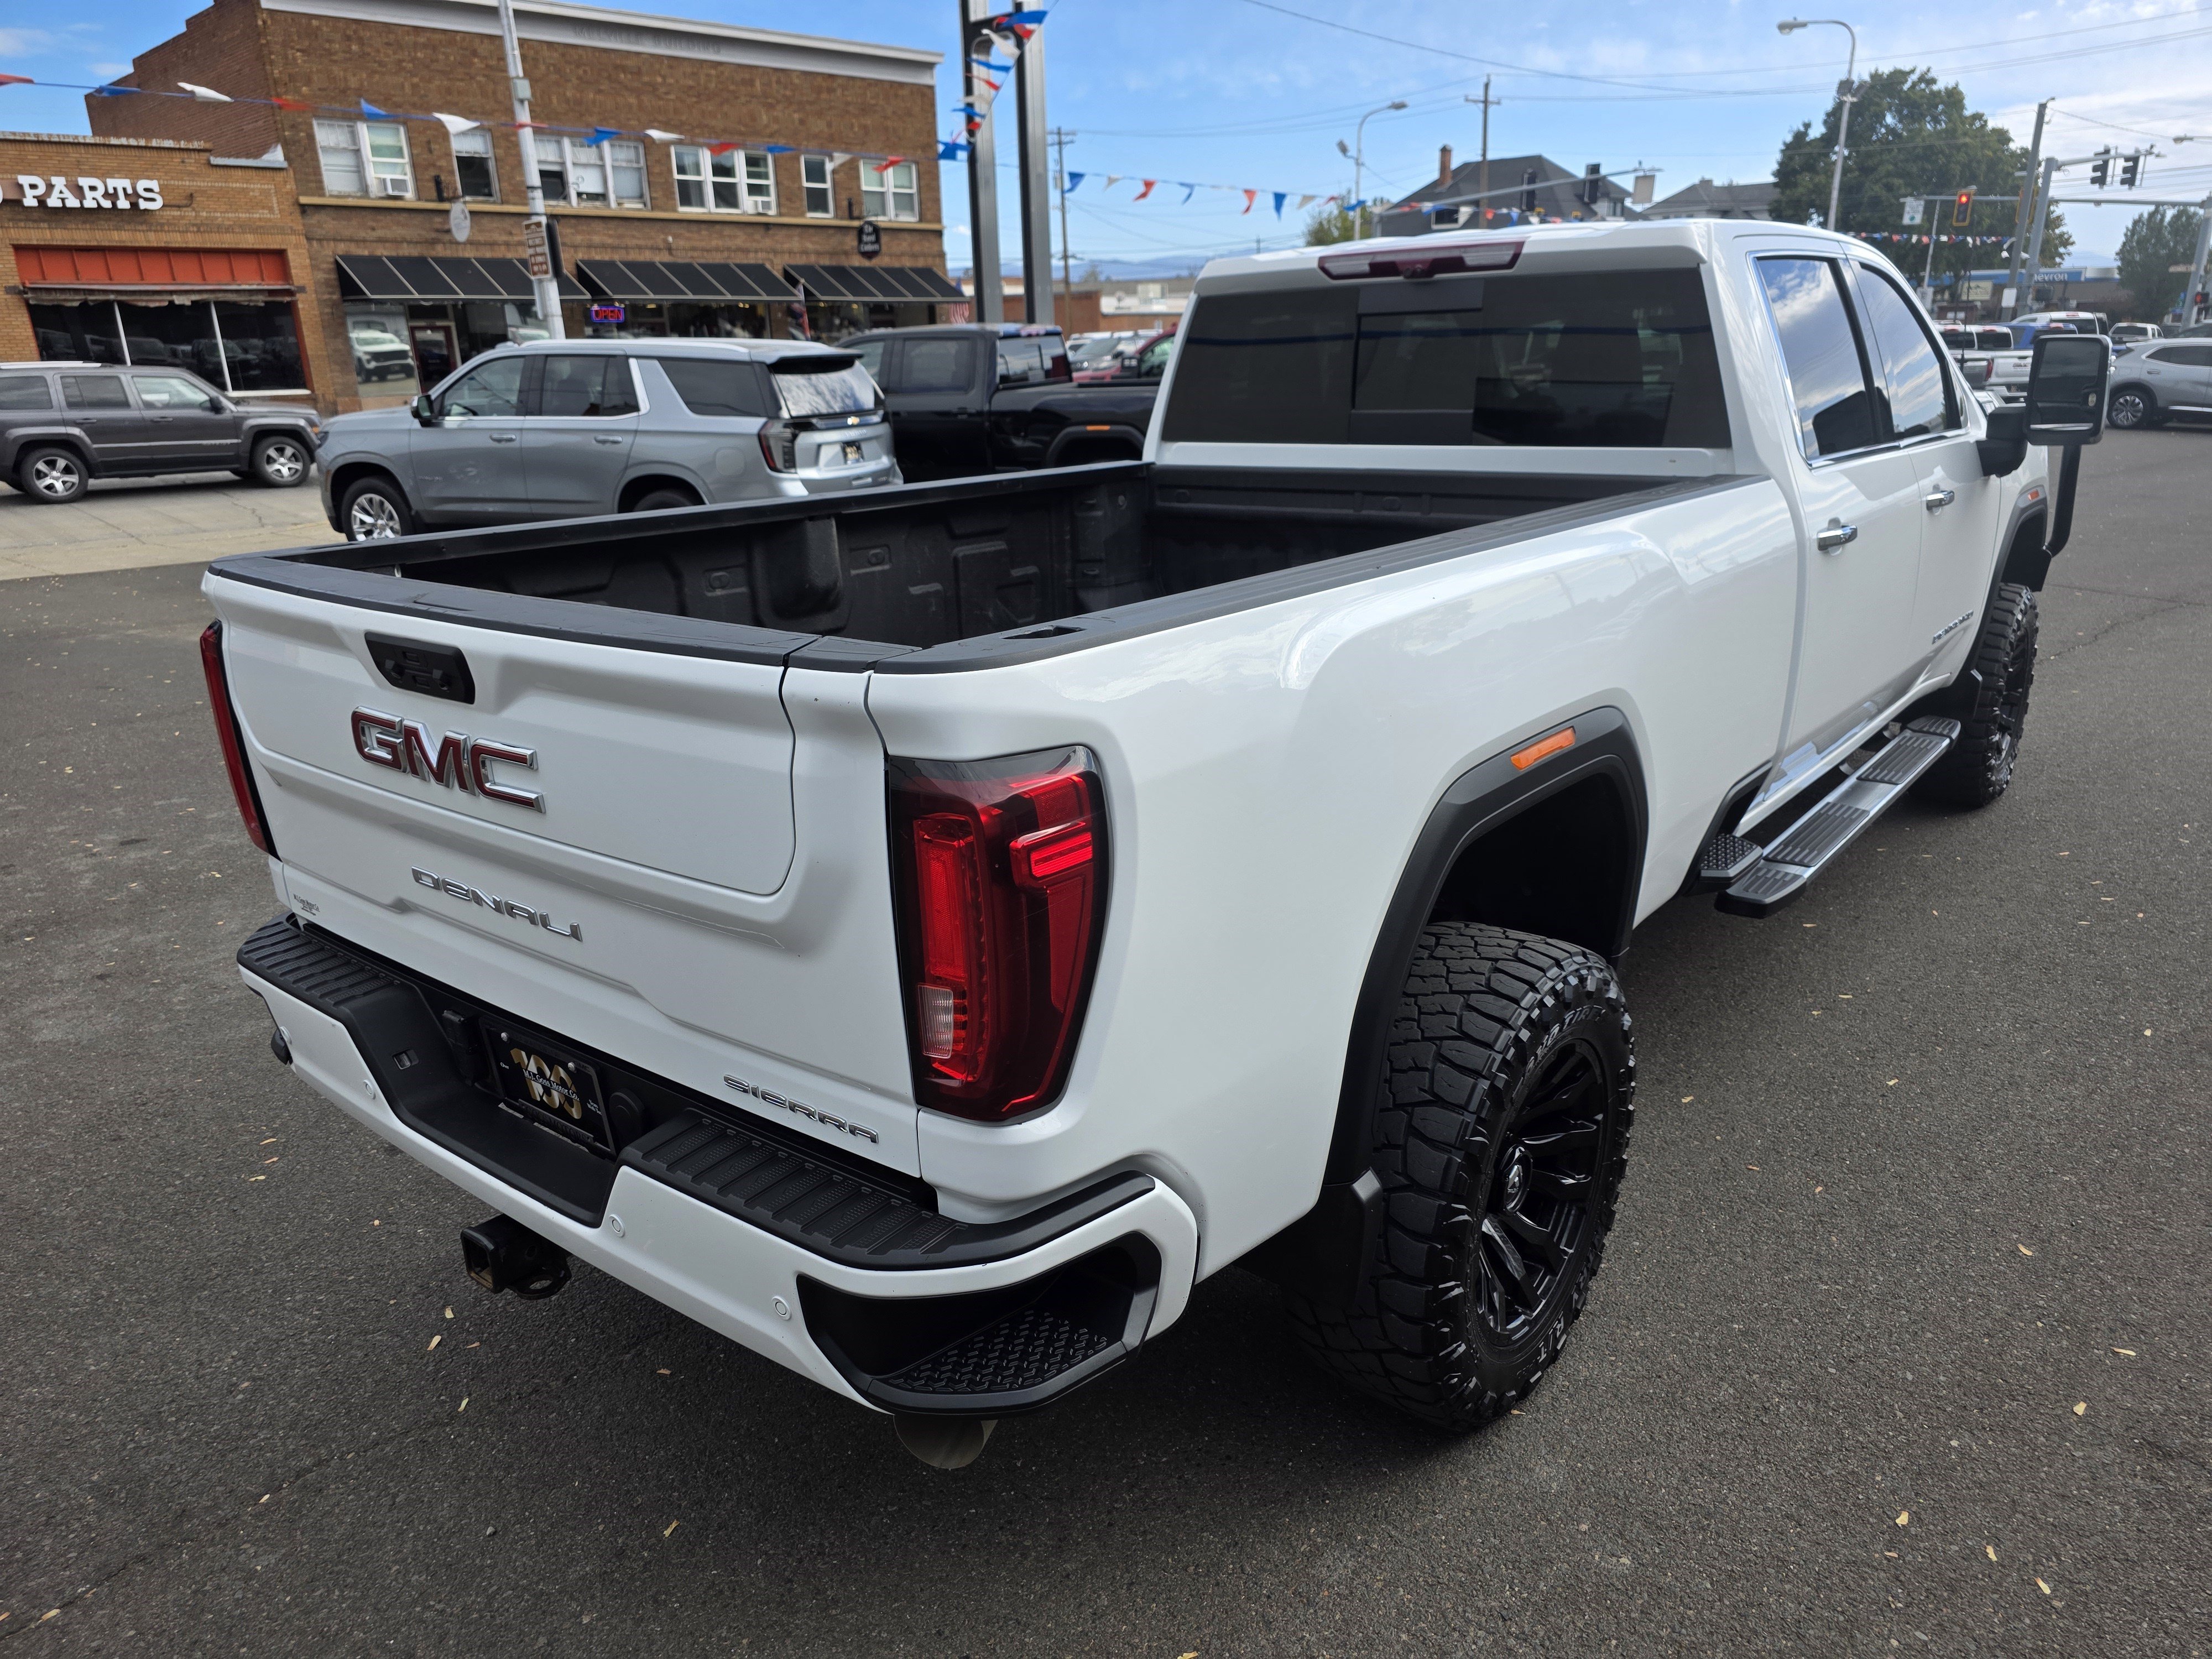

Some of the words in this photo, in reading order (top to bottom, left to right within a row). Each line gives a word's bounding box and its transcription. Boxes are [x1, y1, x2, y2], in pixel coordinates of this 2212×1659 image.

[17, 175, 164, 210] PARTS
[594, 309, 622, 320] OPEN
[351, 706, 546, 813] GMC
[411, 865, 583, 942] DENALI
[510, 1047, 582, 1119] 100
[536, 1074, 551, 1087] Goss
[550, 1081, 568, 1095] Motor
[569, 1089, 580, 1102] Co.
[723, 1074, 879, 1144] SIERRA
